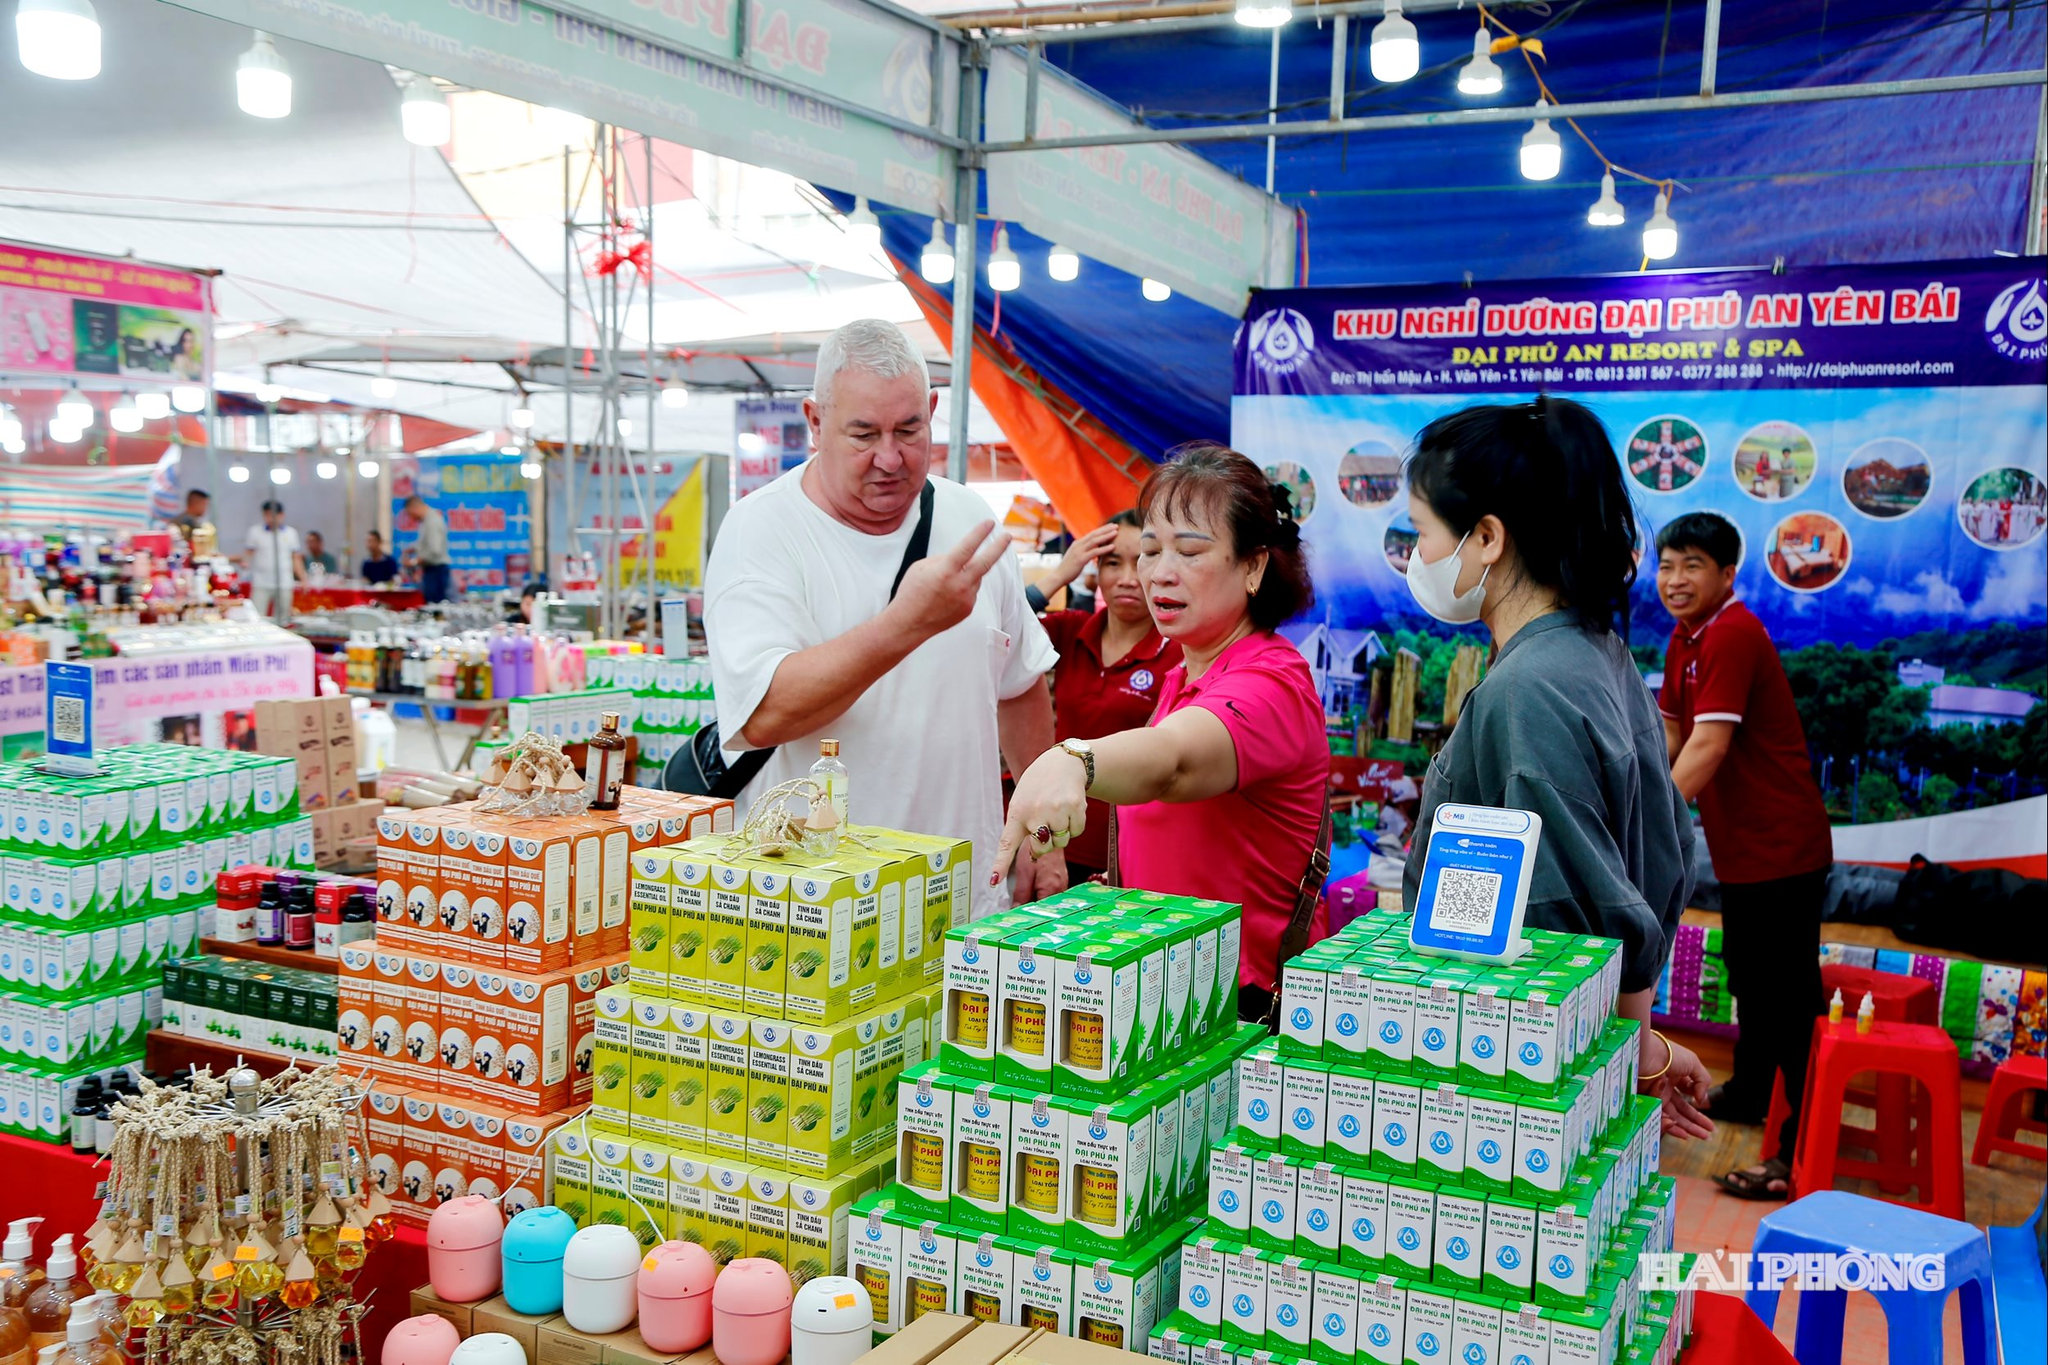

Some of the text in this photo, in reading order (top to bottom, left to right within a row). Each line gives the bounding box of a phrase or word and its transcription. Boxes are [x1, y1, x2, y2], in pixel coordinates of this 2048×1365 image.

[1334, 283, 1960, 338] KHU NGHỈ DƯỠNG ĐẠI PHÚ AN YÊN BÁI
[1452, 338, 1804, 368] ĐẠI PHÚ AN RESORT & SPA
[1422, 370, 1433, 384] A
[1595, 366, 1624, 381] 0813
[1682, 365, 1712, 379] 0377
[1776, 360, 1954, 380] http://daiphuanresort.com
[635, 883, 666, 893] LEMONGRASS
[634, 891, 658, 900] ESSENTIAL
[790, 926, 827, 940] ĐẠI PHÚ AN
[949, 972, 961, 981] ĐẠI
[963, 973, 977, 983] PHÚ
[1005, 982, 1017, 992] ĐẠI
[1019, 983, 1034, 993] PHÚ
[1285, 982, 1297, 990] ĐẠI
[1298, 983, 1312, 992] PHÚ
[1061, 993, 1104, 1006] ĐẠI PHÚ AN
